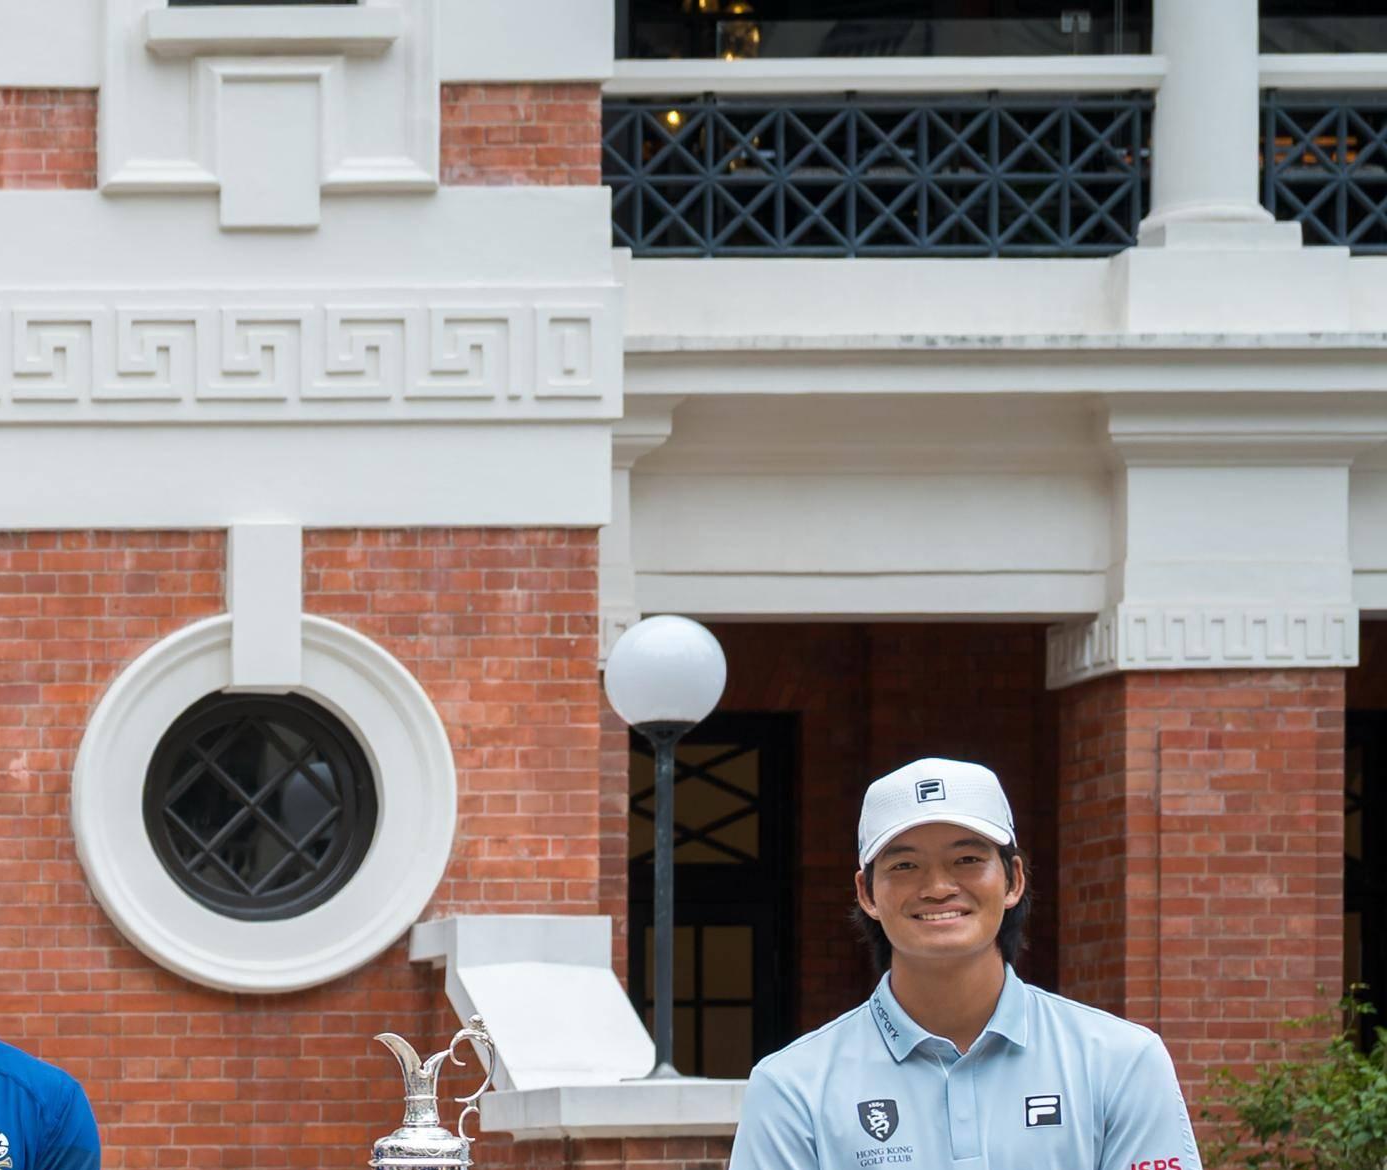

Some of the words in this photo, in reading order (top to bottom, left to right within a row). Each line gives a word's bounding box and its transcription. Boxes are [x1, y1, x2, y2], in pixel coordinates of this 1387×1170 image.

[855, 1147, 885, 1159] HONG
[887, 1145, 914, 1154] KONG
[860, 1156, 885, 1168] GOLF
[887, 1154, 913, 1163] CLUB
